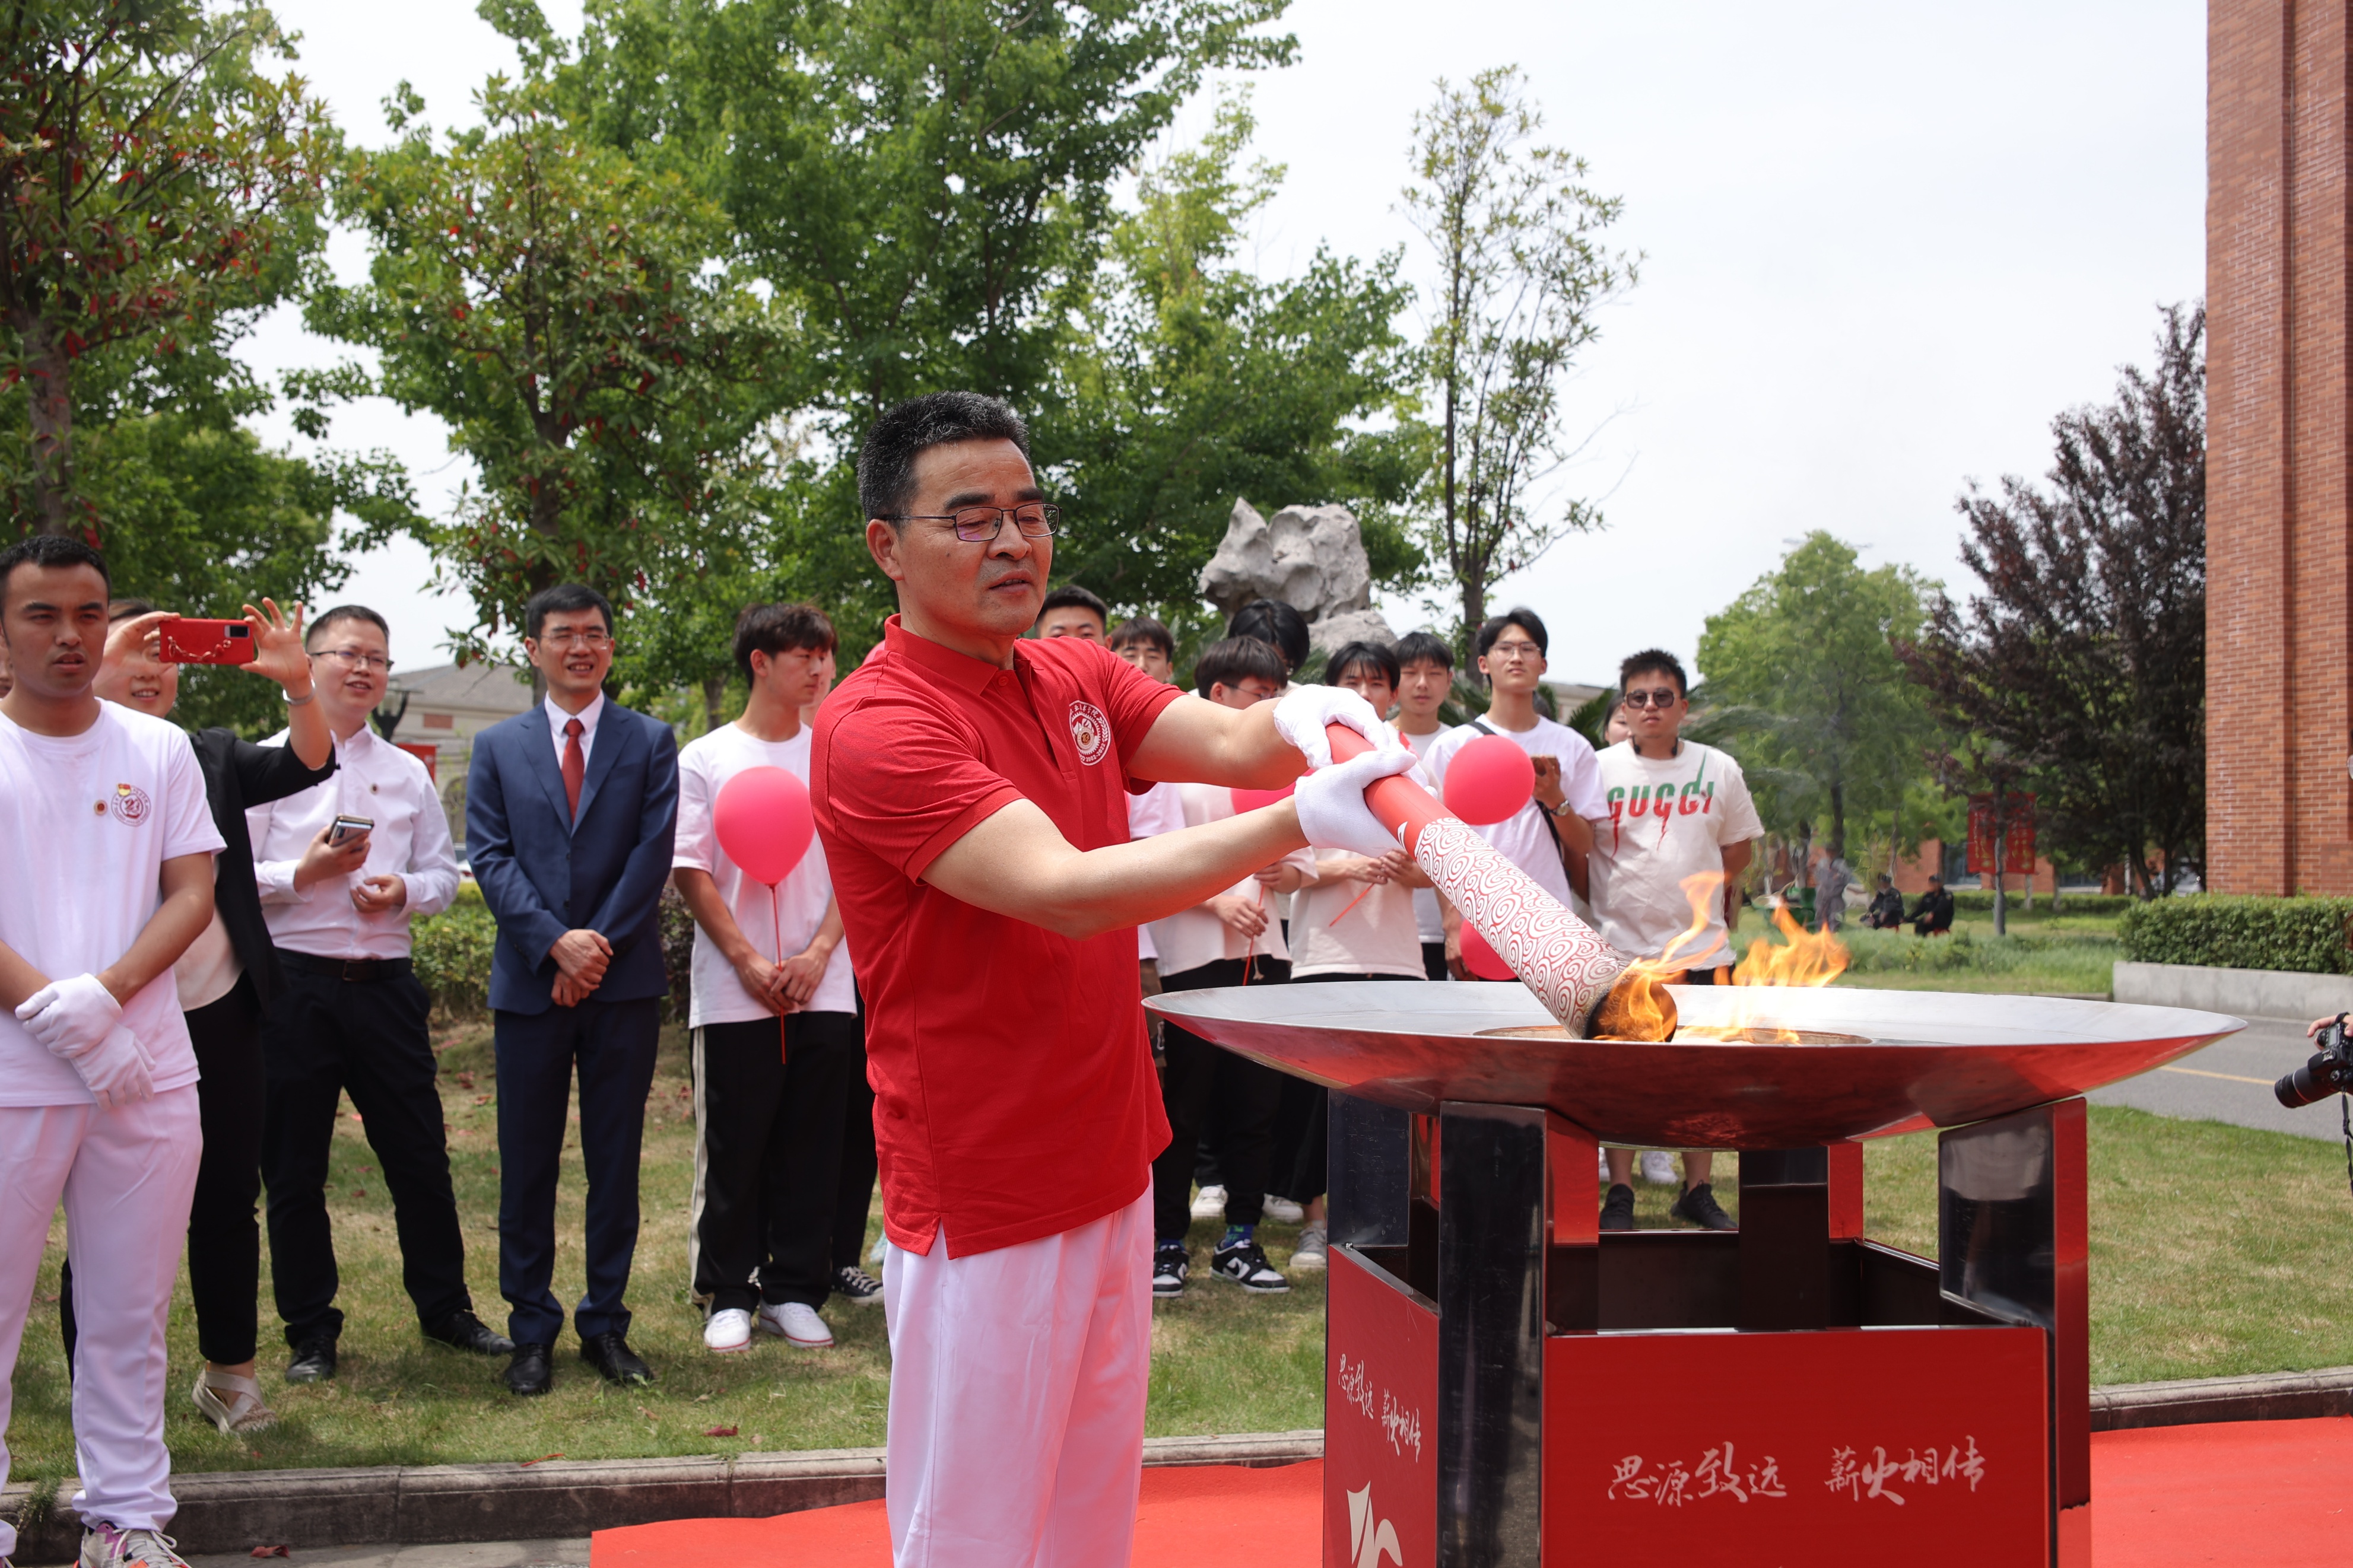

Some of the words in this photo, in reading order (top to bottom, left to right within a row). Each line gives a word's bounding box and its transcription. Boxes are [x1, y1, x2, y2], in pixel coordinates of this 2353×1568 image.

[1086, 743, 1106, 762] 2002-2022
[1338, 1353, 1373, 1419] 思源致远
[1381, 1388, 1421, 1462] 薪火相传
[1608, 1441, 1787, 1506] 思源致远
[1824, 1435, 1985, 1505] 薪火相传
